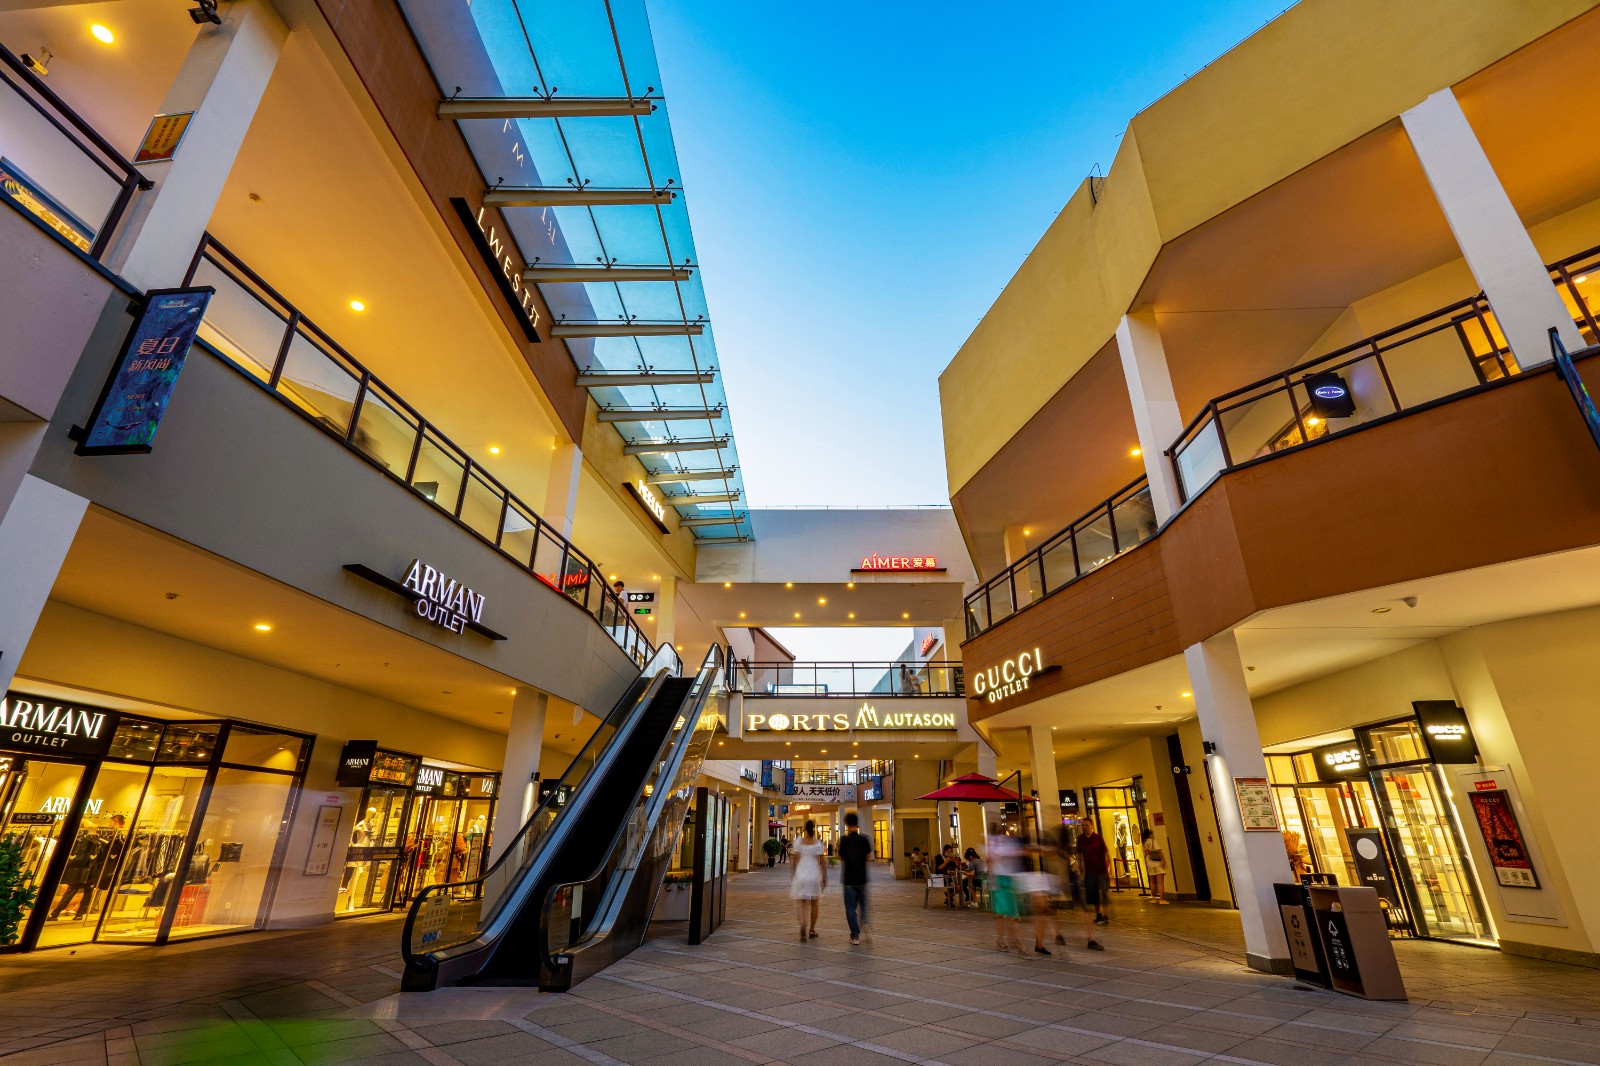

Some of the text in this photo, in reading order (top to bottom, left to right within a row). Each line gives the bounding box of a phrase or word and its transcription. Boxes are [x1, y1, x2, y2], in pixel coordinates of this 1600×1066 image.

[135, 337, 180, 355] 夏日
[128, 358, 171, 373] 新风尚
[912, 556, 936, 568] 爱慕
[402, 558, 486, 624] ARMANI
[417, 598, 468, 635] OUTLET
[974, 647, 1044, 695] GUCCI
[988, 676, 1030, 703] OUTLET
[747, 713, 850, 731] PORTS
[883, 713, 955, 727] AUTASON
[11, 732, 68, 748] OUTLET
